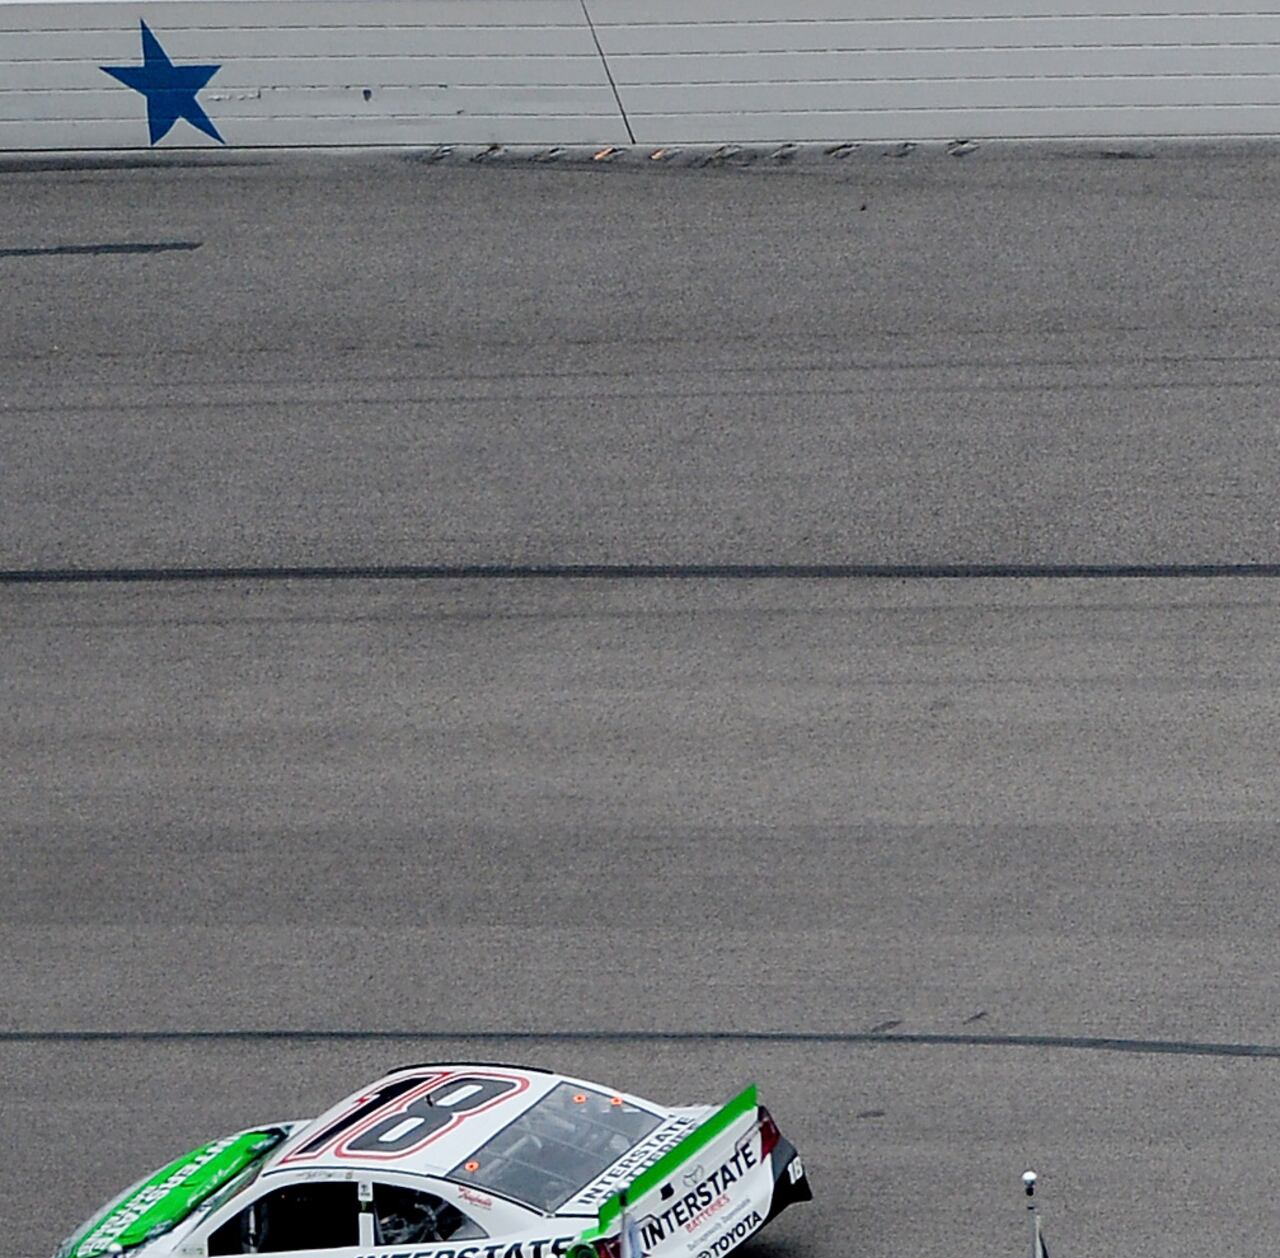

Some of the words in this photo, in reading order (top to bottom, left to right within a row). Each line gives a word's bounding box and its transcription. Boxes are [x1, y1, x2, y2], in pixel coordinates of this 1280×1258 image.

[281, 1072, 530, 1163] 18
[577, 1116, 694, 1204] INTERSTATE
[641, 1142, 758, 1250] INTERSTATE
[711, 1211, 762, 1258] TOYOTA
